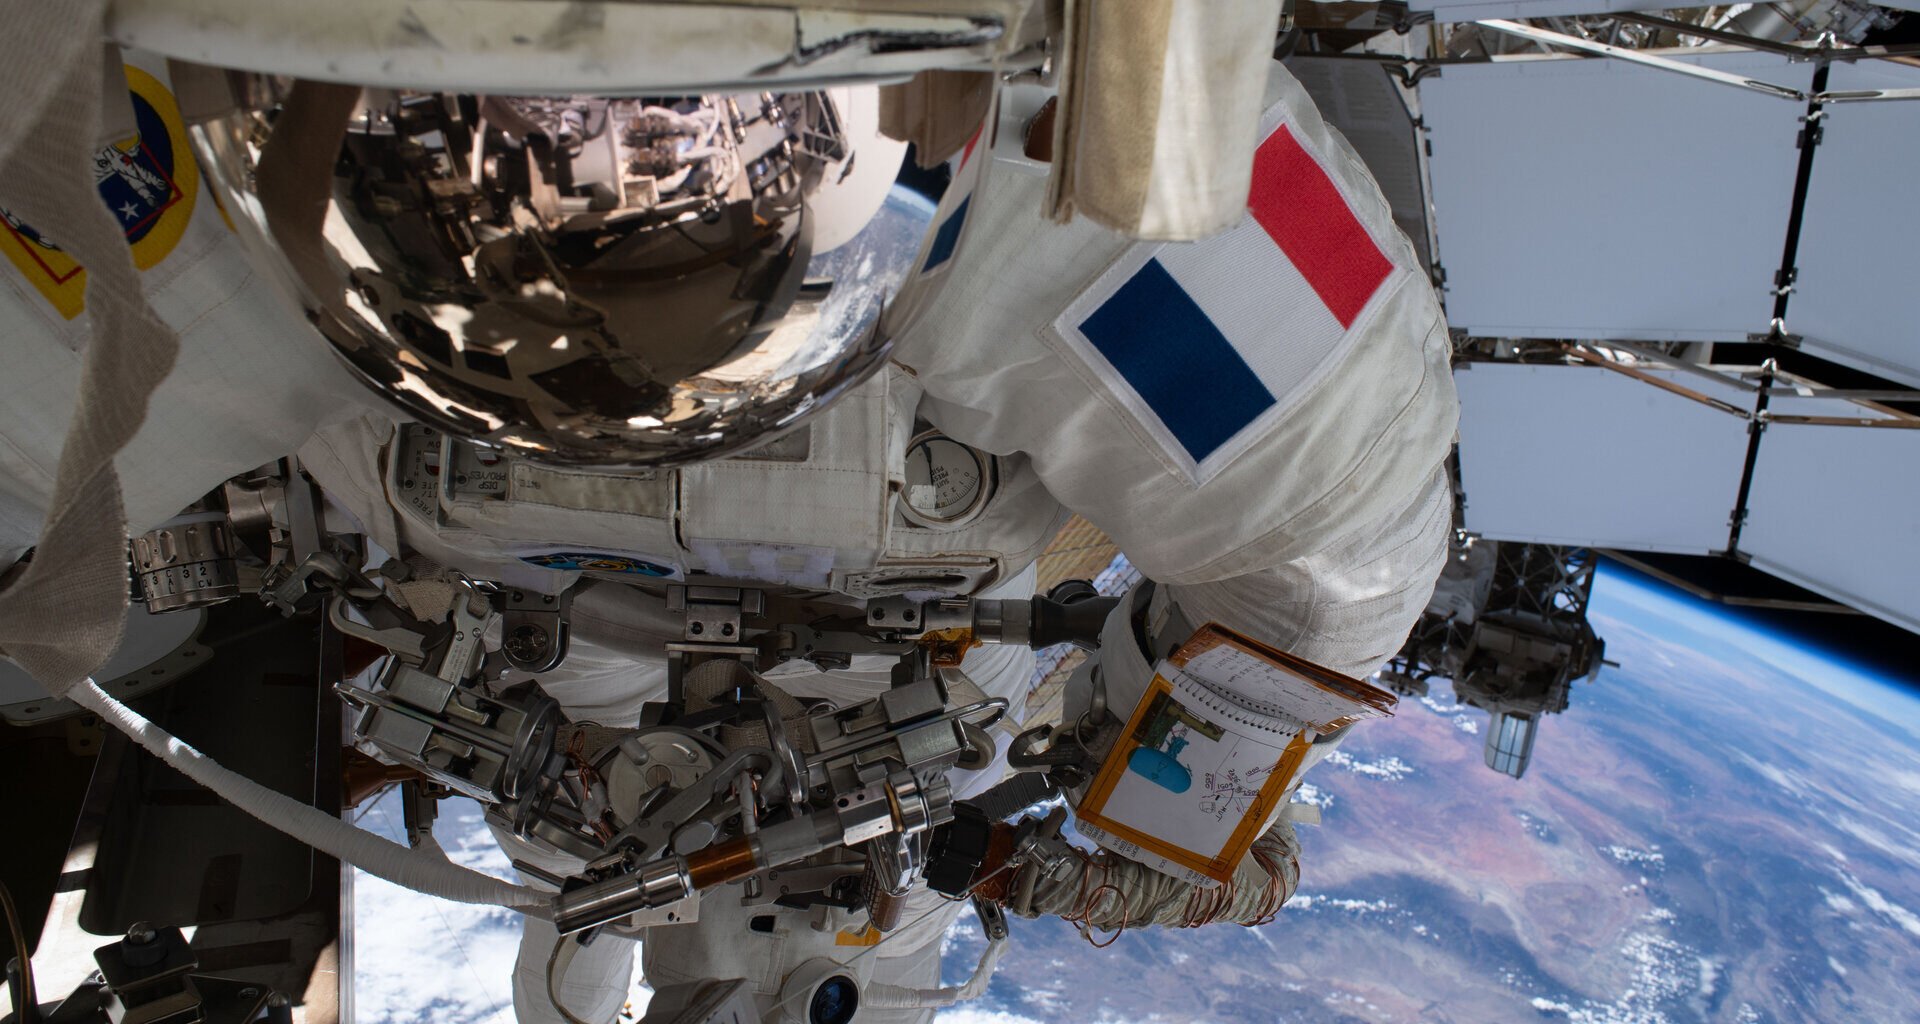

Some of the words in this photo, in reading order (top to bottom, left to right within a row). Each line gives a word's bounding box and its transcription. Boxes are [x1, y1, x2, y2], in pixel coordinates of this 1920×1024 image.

[470, 470, 507, 480] PRO/YES
[932, 471, 949, 481] PRESS
[479, 482, 498, 490] DISP
[936, 478, 950, 488] SUIT
[412, 497, 434, 516] FREQ
[182, 570, 190, 578] 3
[200, 566, 206, 576] 2
[152, 576, 158, 585] 3
[198, 580, 212, 588] CW
